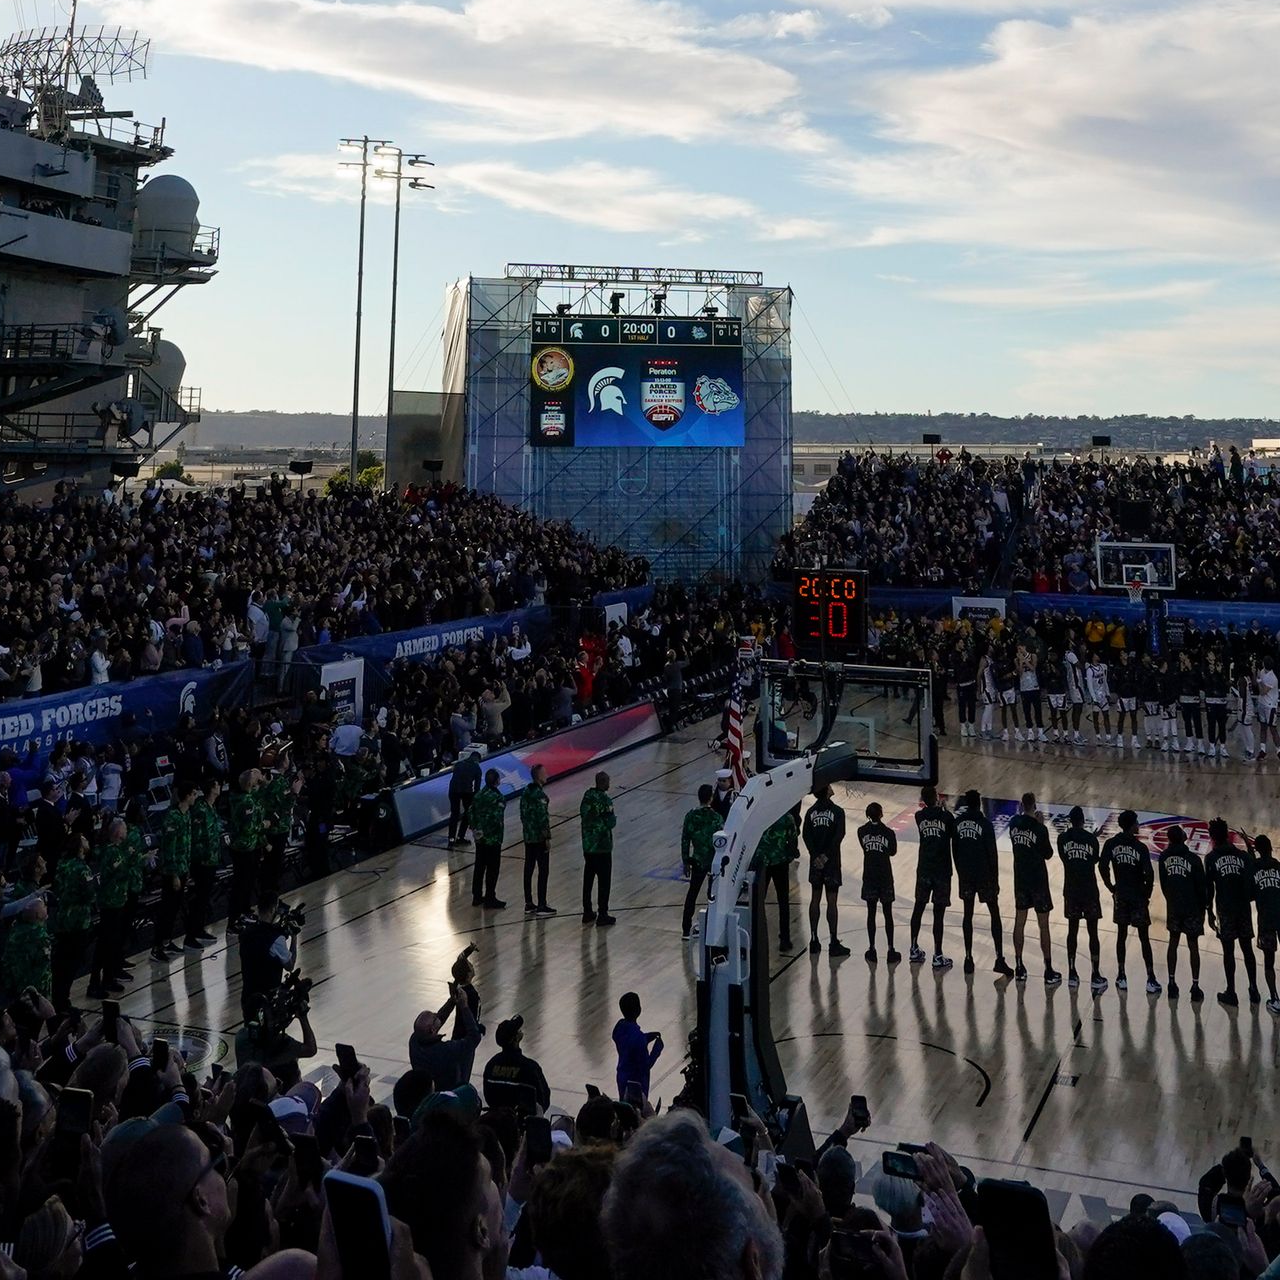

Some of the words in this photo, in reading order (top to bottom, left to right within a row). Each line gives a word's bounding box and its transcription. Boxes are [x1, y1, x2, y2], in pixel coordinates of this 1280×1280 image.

[601, 325, 610, 337] 0
[623, 323, 654, 334] 20:00
[667, 326, 676, 338] 0
[648, 367, 677, 375] Peraton
[652, 413, 675, 421] ESPN
[395, 634, 439, 659] ARMED
[441, 626, 486, 647] FORCES
[41, 695, 122, 732] FORCES
[810, 809, 835, 822] MICHIGAN
[813, 817, 830, 827] STATE
[920, 819, 946, 831] MICHIGAN
[956, 819, 983, 836] MICHIGAN
[923, 827, 941, 838] STATE
[960, 828, 977, 840] STATE
[1011, 827, 1037, 844] MICHIGAN
[862, 833, 889, 848] MICHIGAN
[865, 841, 883, 853] STATE
[1013, 835, 1031, 848] STATE
[1063, 840, 1094, 856] MICHIGAN
[1067, 848, 1088, 861] STATE
[1112, 845, 1141, 862] MICHIGAN
[1116, 854, 1136, 866] STATE
[1163, 855, 1192, 872] MICHIGAN
[1214, 854, 1245, 868] MICHIGAN
[1167, 864, 1187, 877] STATE
[1220, 863, 1241, 876] STATE
[1259, 877, 1280, 890] STATE
[491, 1064, 521, 1079] NAVY
